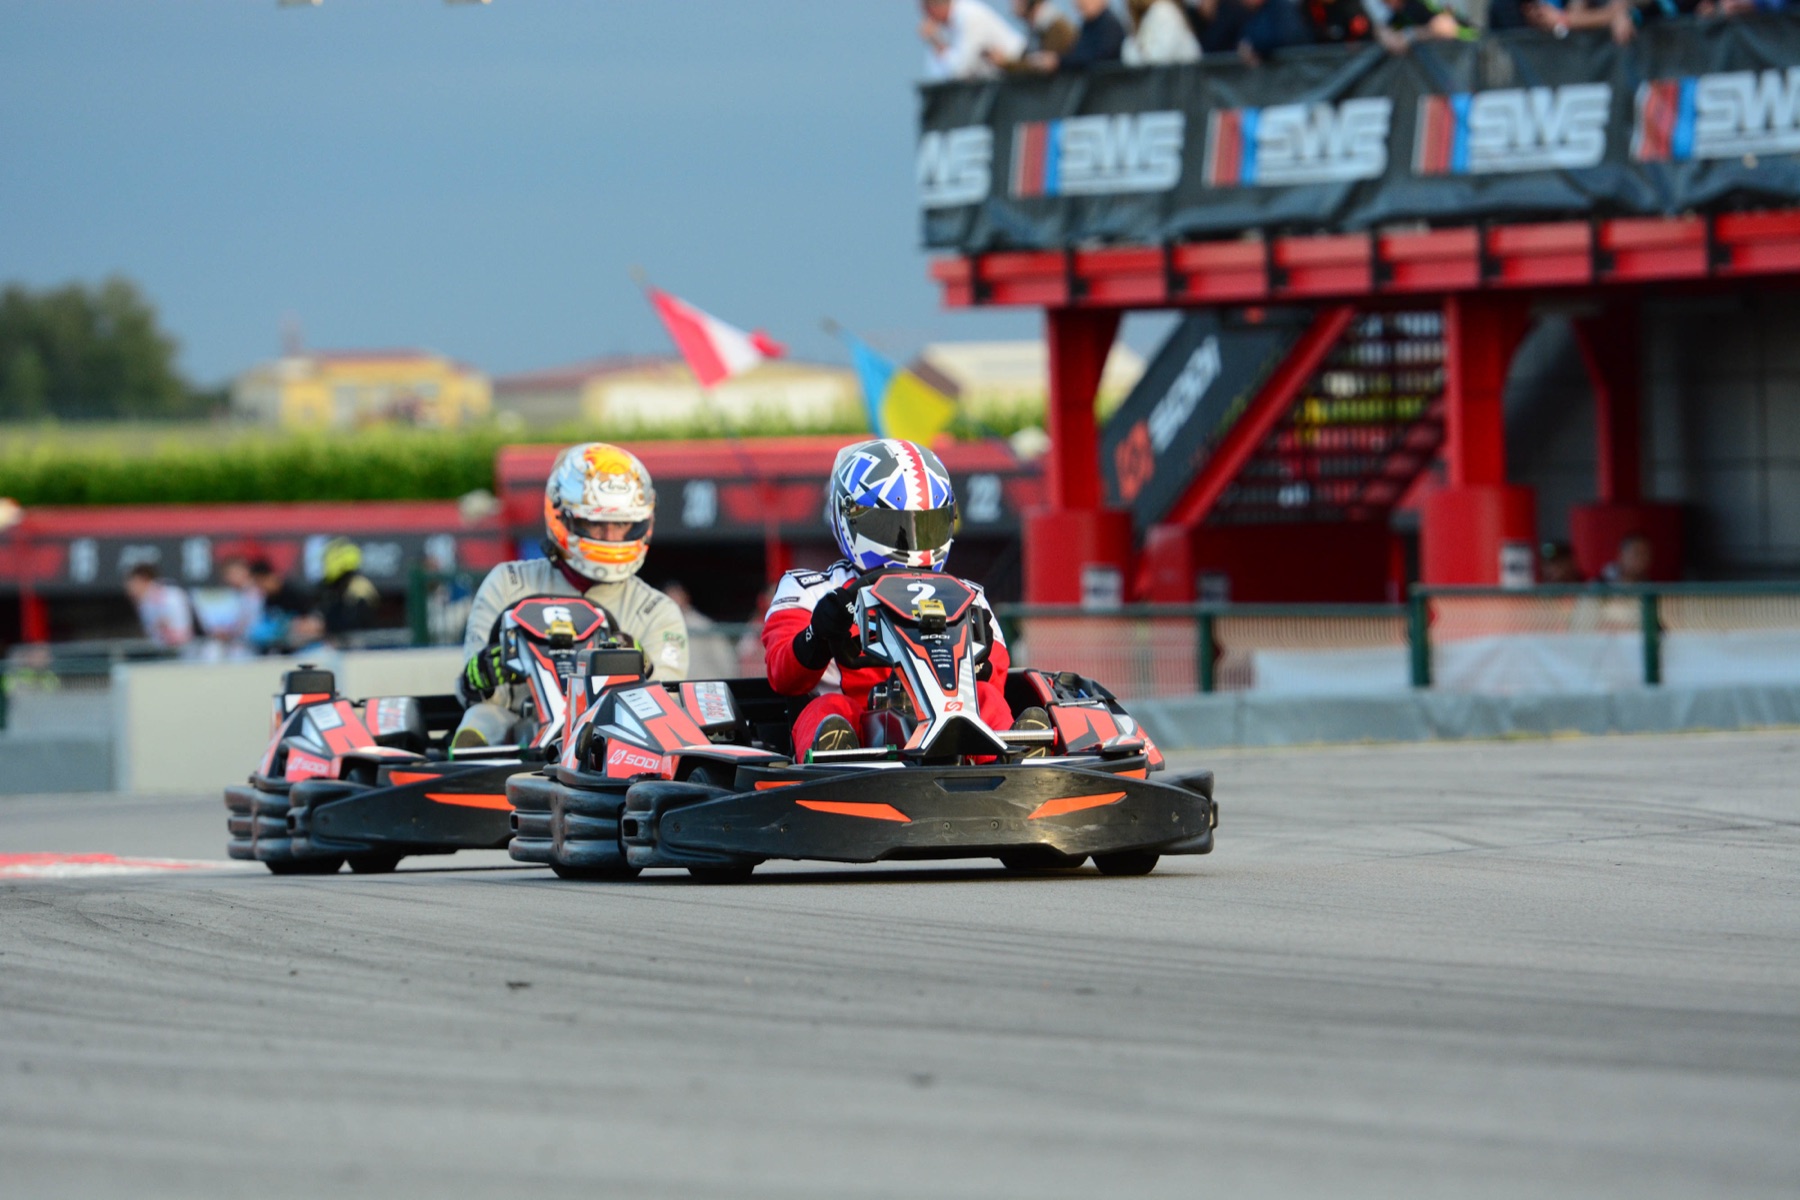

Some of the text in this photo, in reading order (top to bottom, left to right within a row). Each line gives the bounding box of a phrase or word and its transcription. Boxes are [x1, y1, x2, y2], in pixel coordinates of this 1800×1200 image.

[1061, 110, 1185, 195] SWS
[1257, 96, 1391, 186] SWS
[1468, 83, 1611, 173] SWS
[1694, 68, 1800, 159] SW
[917, 125, 993, 206] WS
[542, 606, 572, 626] 6
[907, 583, 936, 605] 2
[624, 753, 659, 770] SODI
